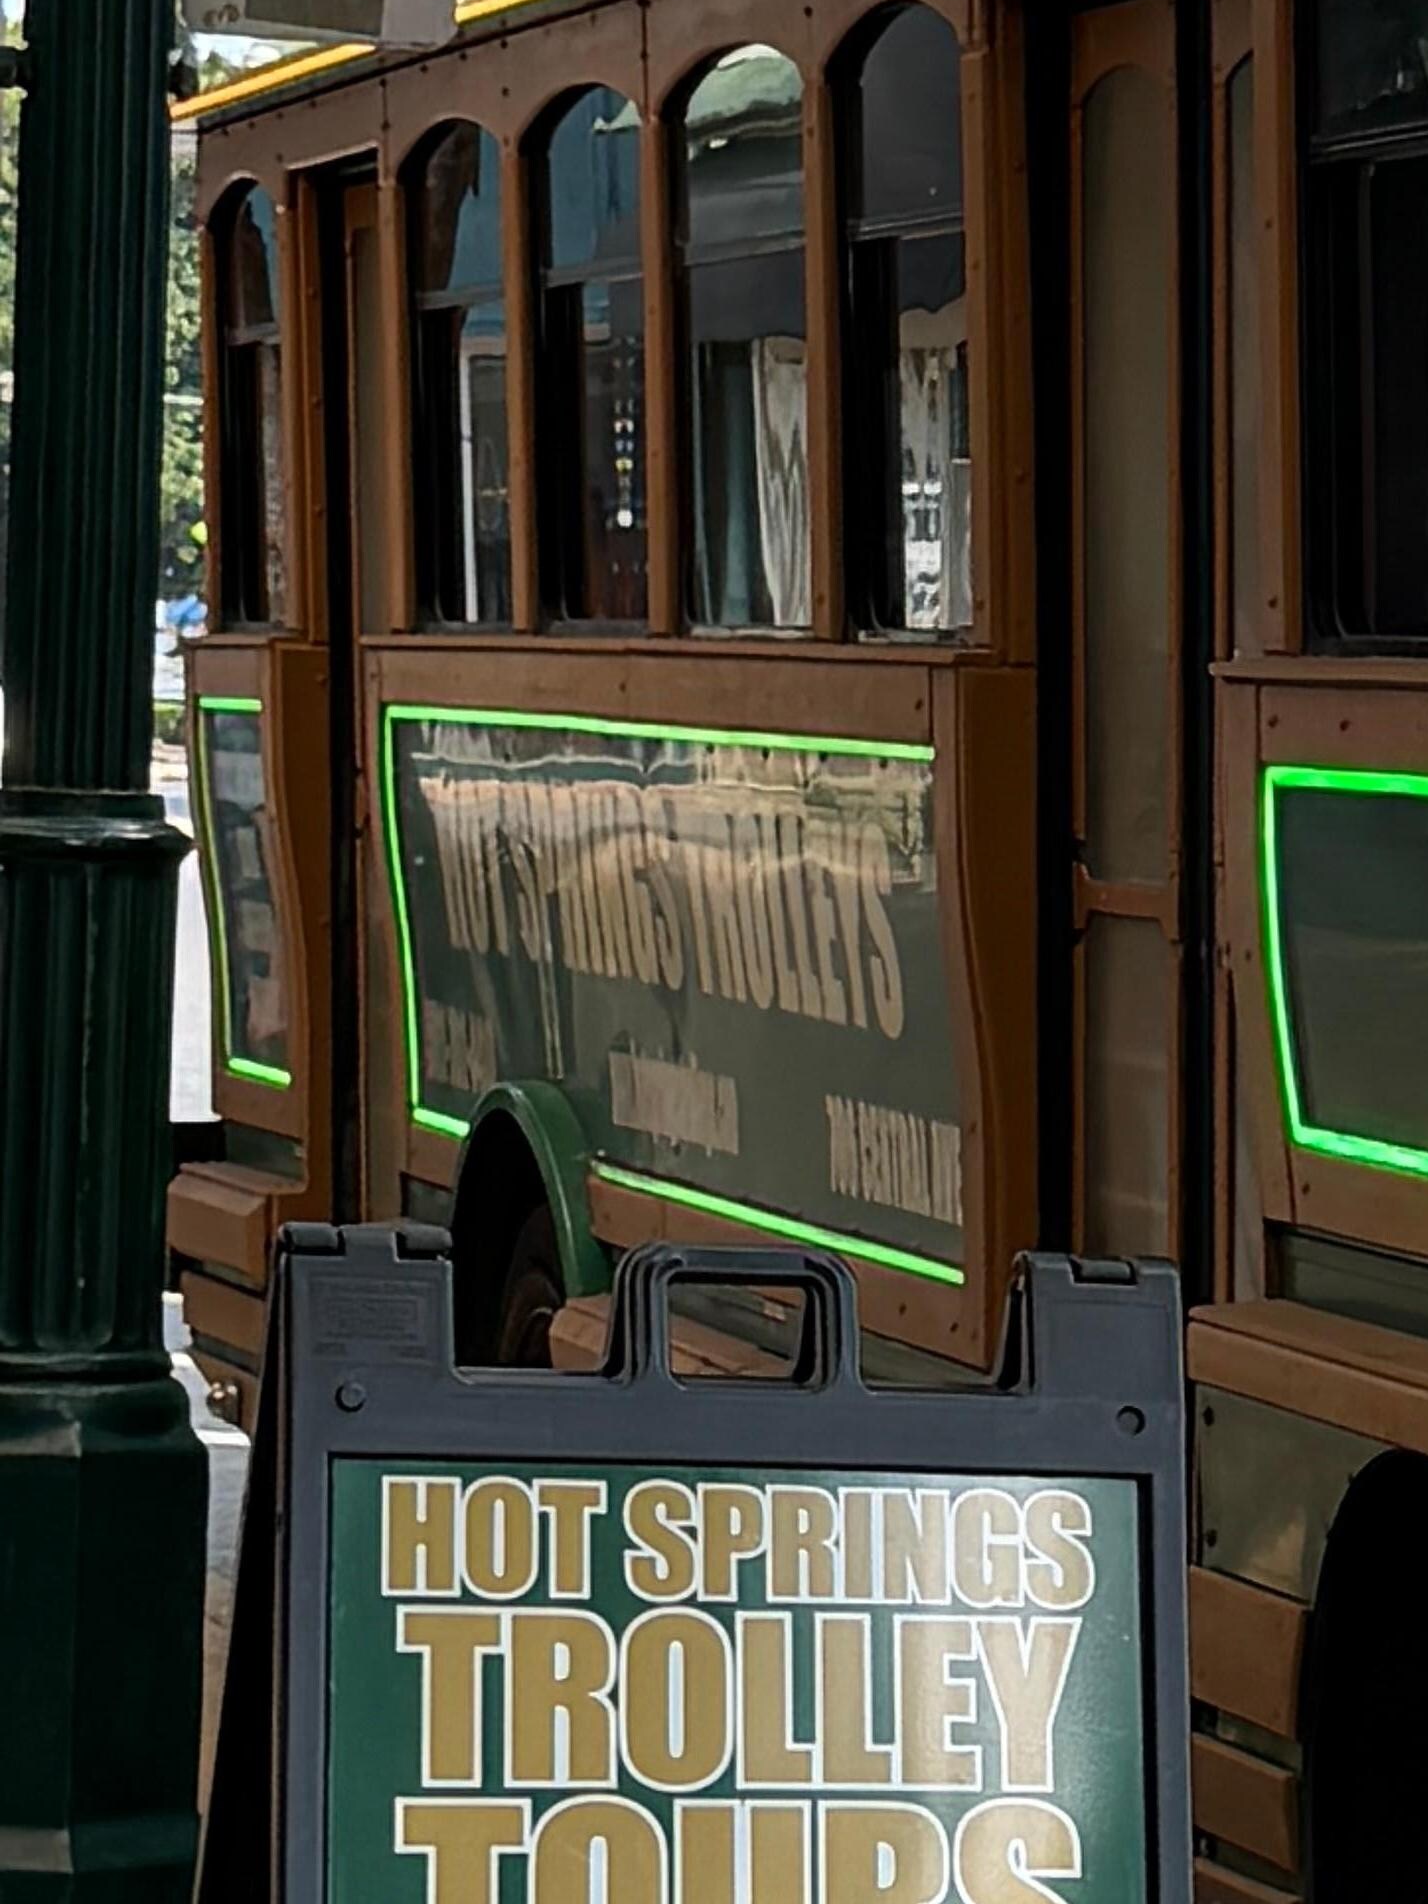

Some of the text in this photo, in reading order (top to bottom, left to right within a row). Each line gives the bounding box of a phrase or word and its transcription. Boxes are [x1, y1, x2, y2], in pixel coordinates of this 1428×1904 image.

[664, 796, 905, 1040] TROLLEYS
[381, 1474, 1094, 1609] HOT SPRINGS
[395, 1604, 1083, 1793] TROLLEY
